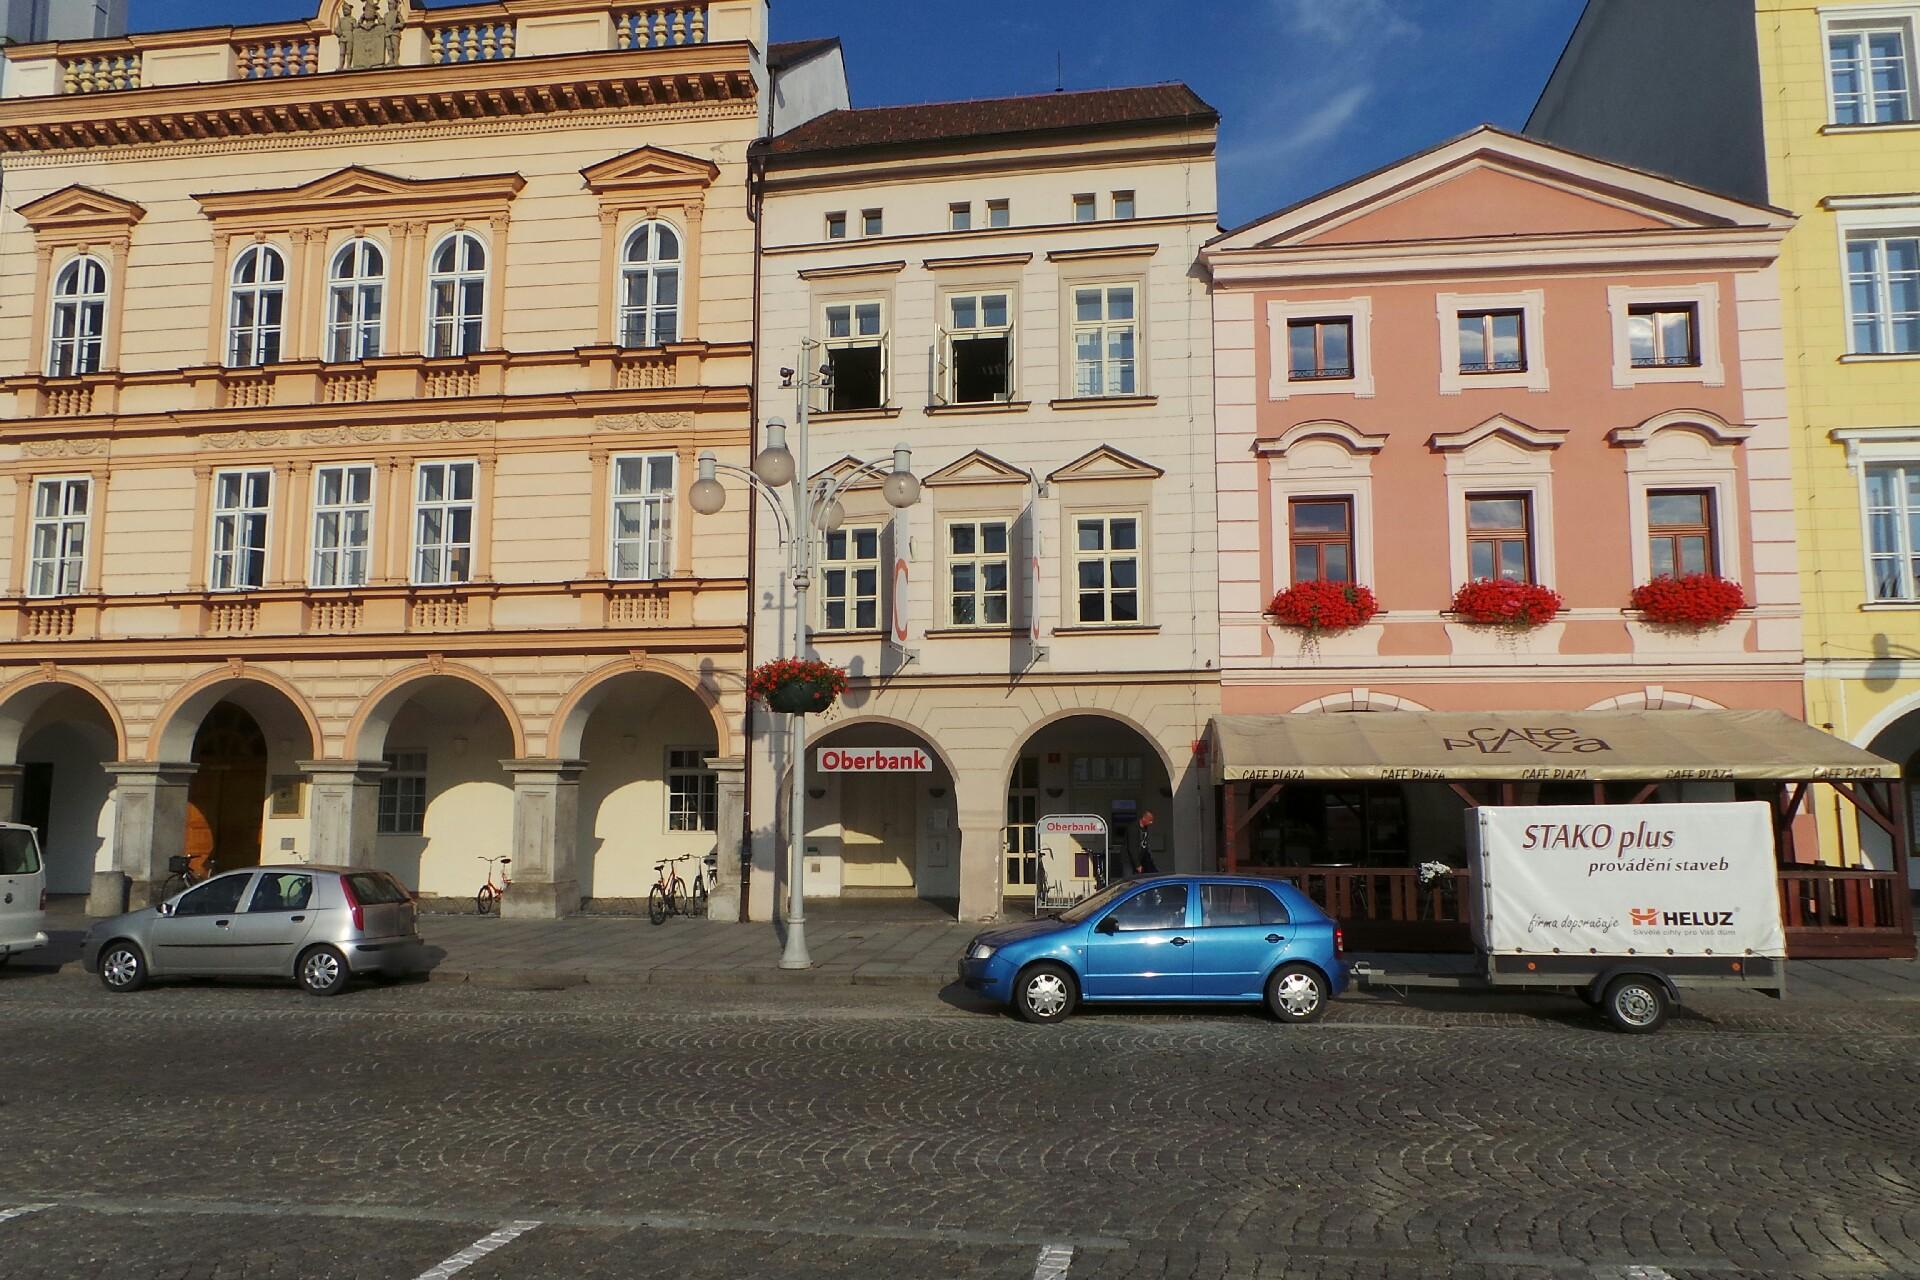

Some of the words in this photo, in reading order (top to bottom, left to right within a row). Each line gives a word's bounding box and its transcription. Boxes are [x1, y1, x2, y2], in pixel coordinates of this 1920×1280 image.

[822, 750, 926, 770] Oberbank
[1242, 769, 1269, 780] CAFE
[1381, 769, 1408, 780] CAFE
[1522, 768, 1550, 780] CAFE
[1665, 769, 1694, 780] CAFE
[1812, 767, 1841, 779] CAFE
[1046, 822, 1096, 831] Oberbank
[1522, 823, 1612, 849] STAKO
[1617, 820, 1676, 857] plus
[1588, 857, 1672, 876] provádění
[1674, 856, 1729, 871] staveb
[1528, 913, 1558, 933] firma
[1663, 911, 1734, 926] HELUZ
